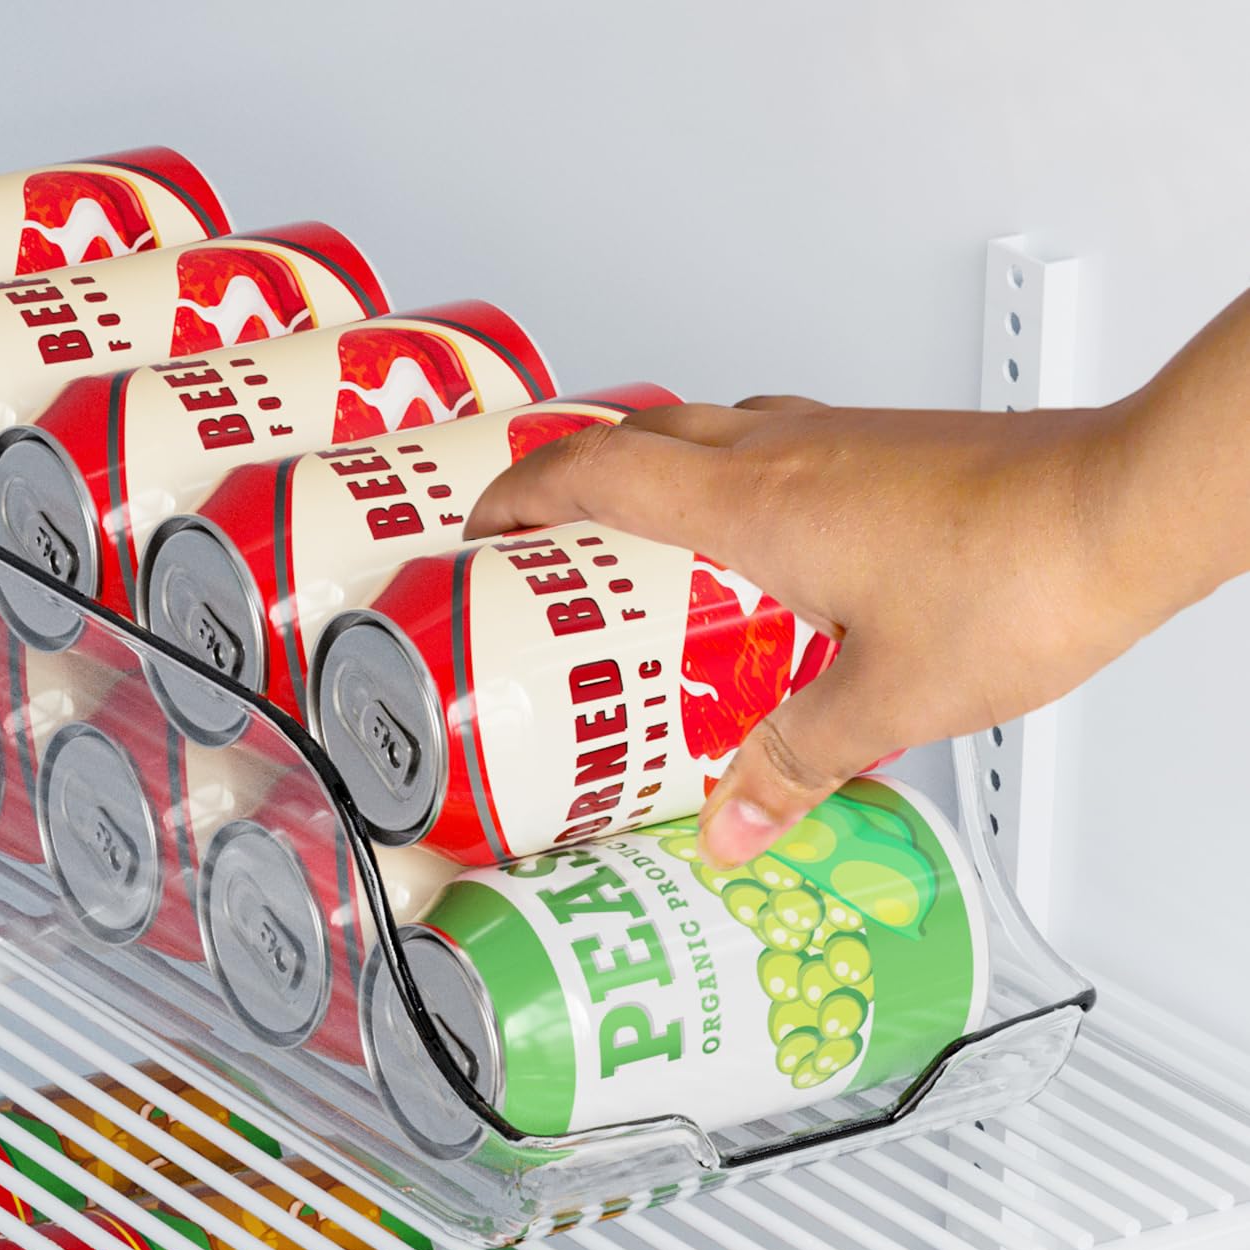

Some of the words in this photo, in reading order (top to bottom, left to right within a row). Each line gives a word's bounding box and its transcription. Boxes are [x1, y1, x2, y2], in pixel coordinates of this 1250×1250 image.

[553, 658, 628, 844] ORNED
[605, 841, 690, 911] PRODUC
[679, 919, 721, 1055] ORGANIC
